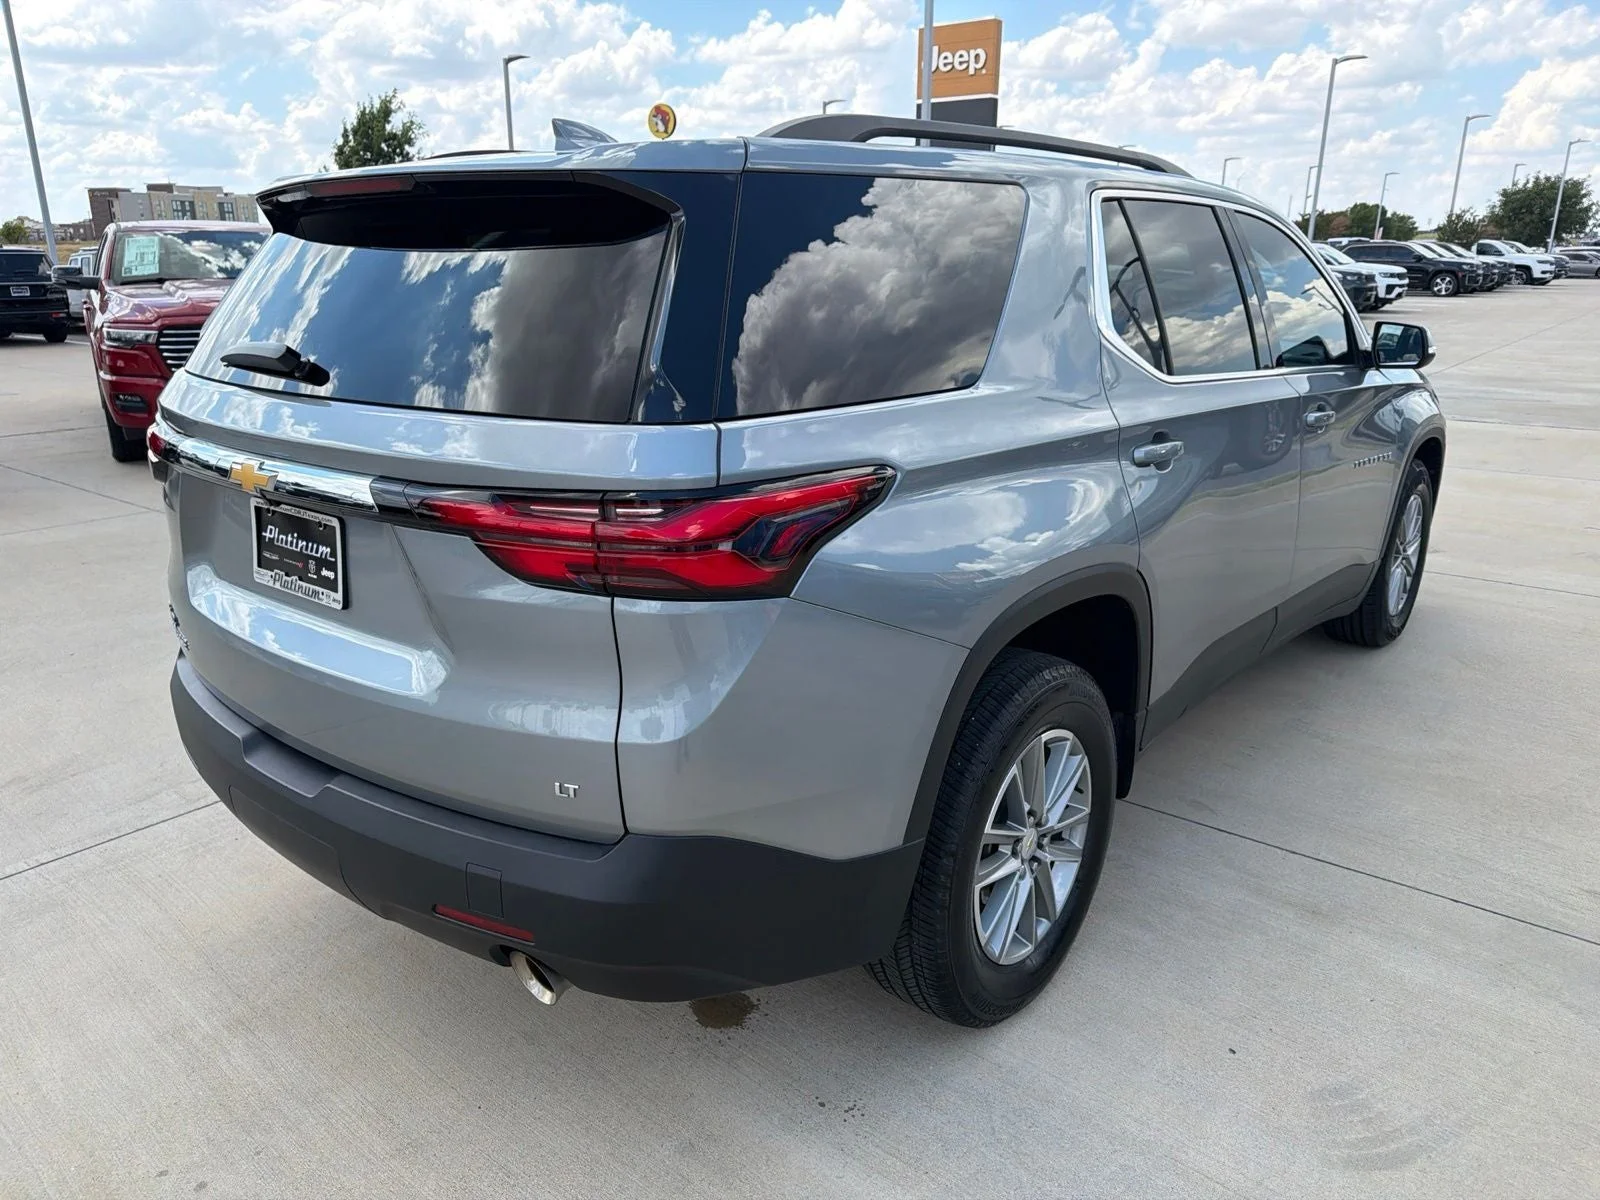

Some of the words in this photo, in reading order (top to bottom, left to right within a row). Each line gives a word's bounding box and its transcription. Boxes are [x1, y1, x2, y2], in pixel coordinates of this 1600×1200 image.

[922, 45, 986, 75] Jeep
[262, 525, 335, 561] Platinum
[273, 572, 323, 602] Platinum
[554, 782, 580, 798] LT
